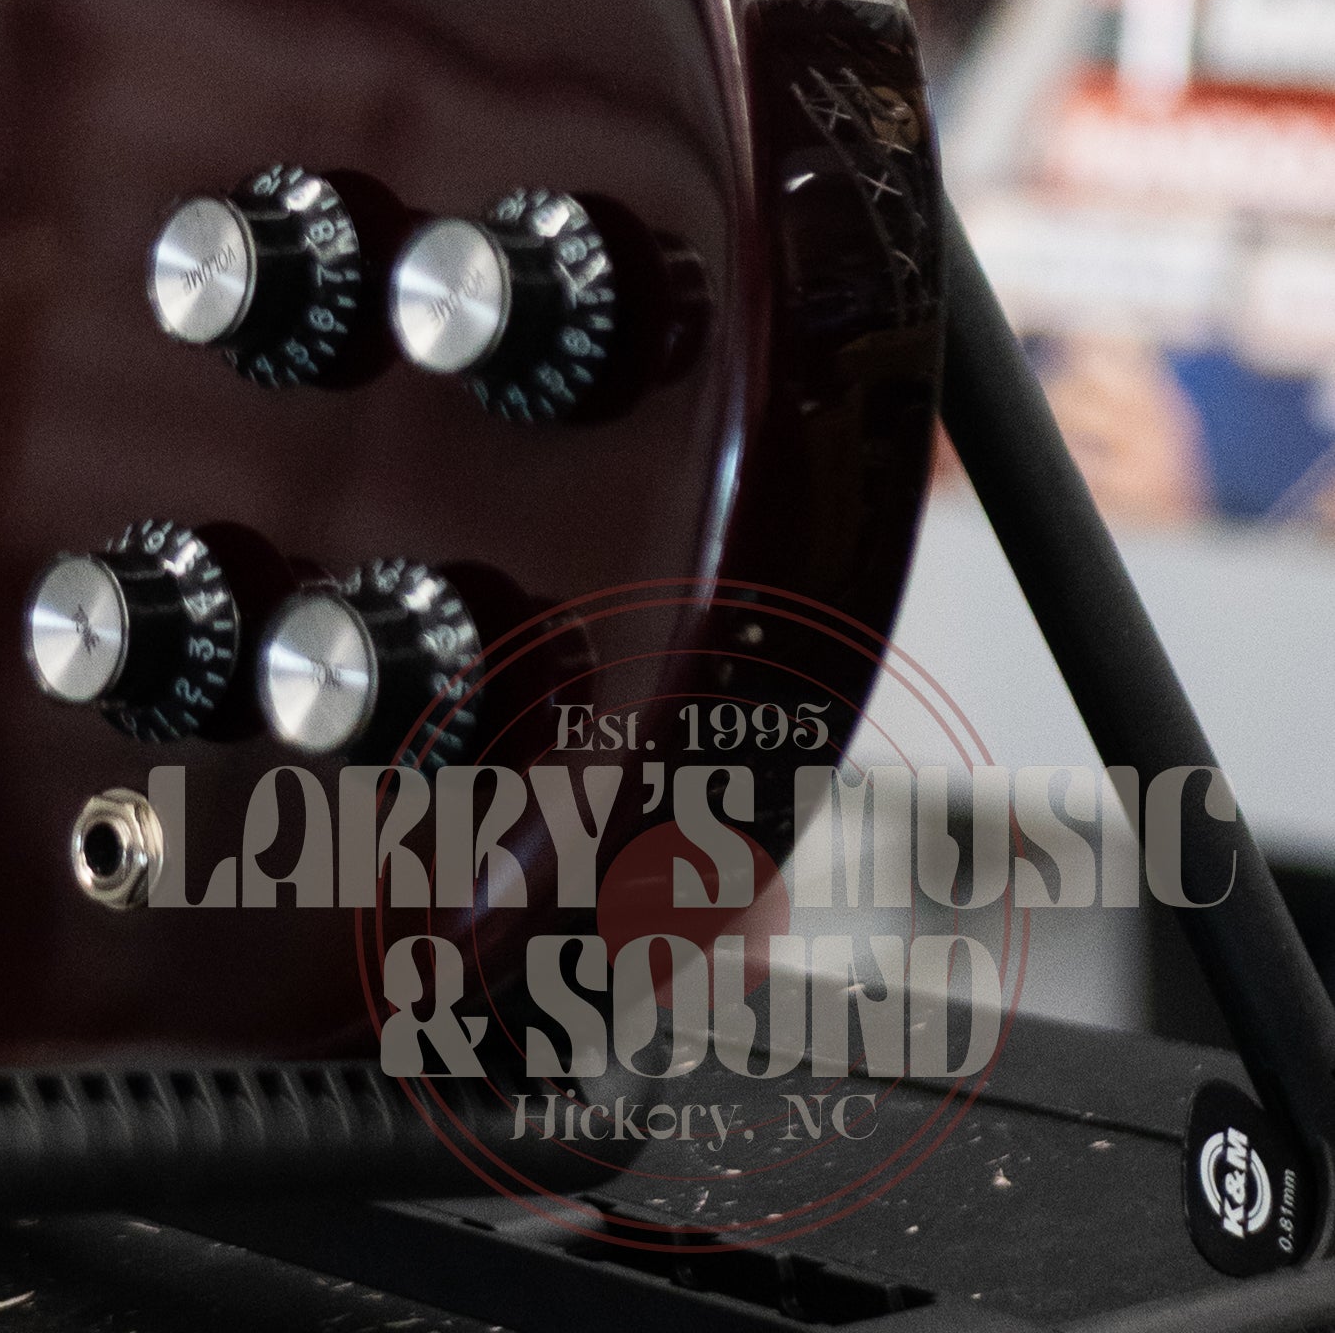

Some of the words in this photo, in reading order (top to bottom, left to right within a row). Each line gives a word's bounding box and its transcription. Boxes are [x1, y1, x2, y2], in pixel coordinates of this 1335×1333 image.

[309, 219, 335, 244] 8
[180, 244, 237, 290] VOLUME
[188, 637, 215, 662] 3
[174, 677, 203, 704] 2
[1221, 1126, 1249, 1240] K&M
[1277, 1168, 1298, 1255] 0.81mm
